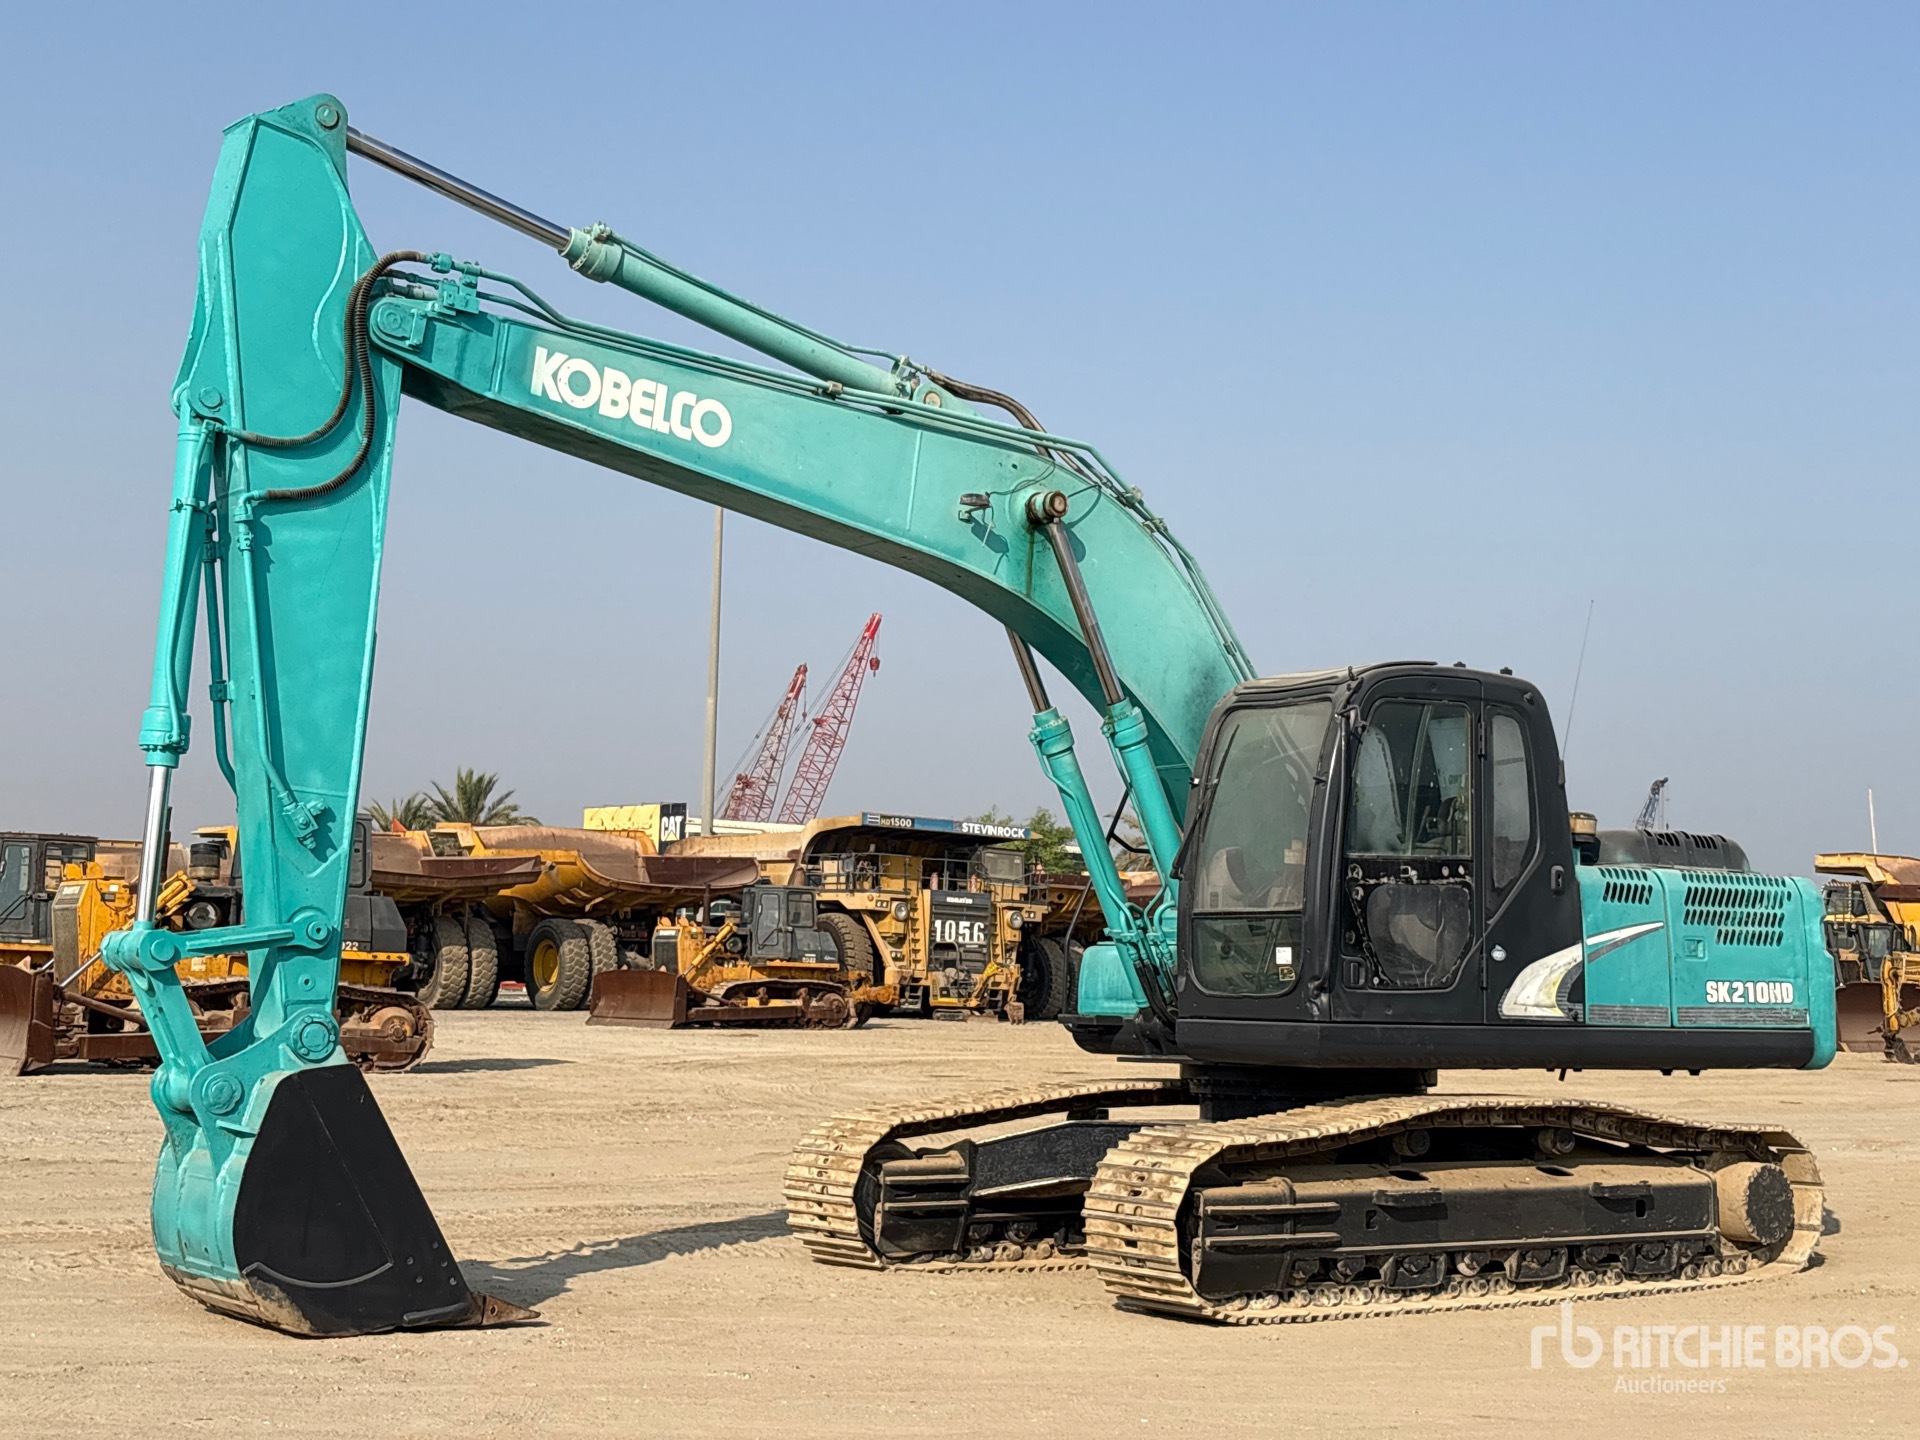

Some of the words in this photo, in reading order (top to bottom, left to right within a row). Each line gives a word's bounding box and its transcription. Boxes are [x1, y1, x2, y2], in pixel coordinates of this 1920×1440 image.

[530, 346, 732, 448] KOBELCO
[661, 815, 684, 841] CAT
[880, 817, 912, 828] HD1500
[962, 822, 1026, 839] STEVINROCK
[934, 919, 985, 943] 1056
[1705, 980, 1794, 1004] SK210HD
